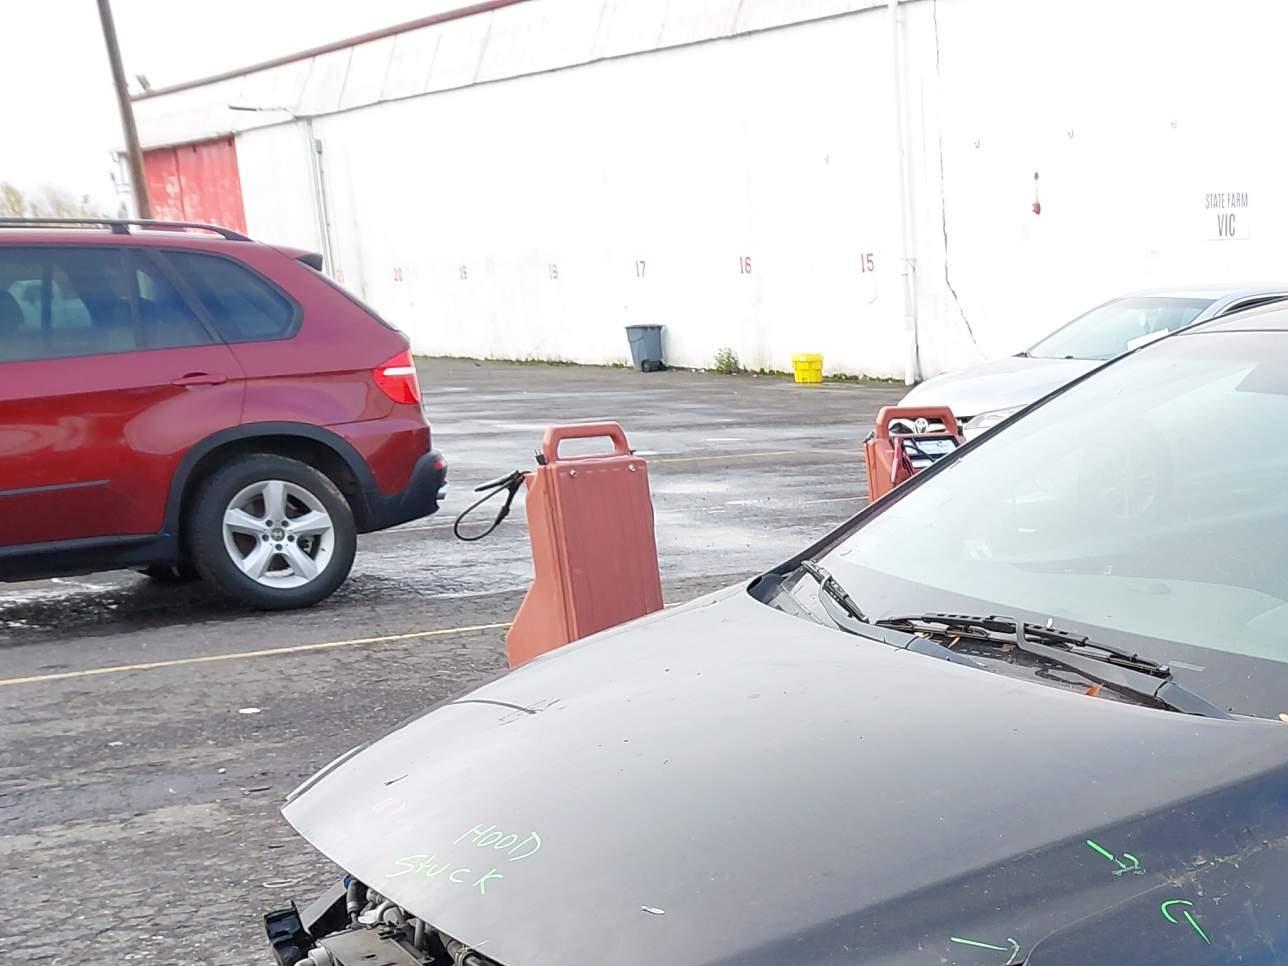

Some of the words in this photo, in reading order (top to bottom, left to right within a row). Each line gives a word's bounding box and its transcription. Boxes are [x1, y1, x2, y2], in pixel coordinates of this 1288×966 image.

[1205, 192, 1225, 209] STATE
[1227, 191, 1249, 208] FARM
[1217, 213, 1236, 237] VIC
[635, 260, 646, 278] 17
[861, 253, 875, 273] 15
[453, 824, 542, 861] HOOD
